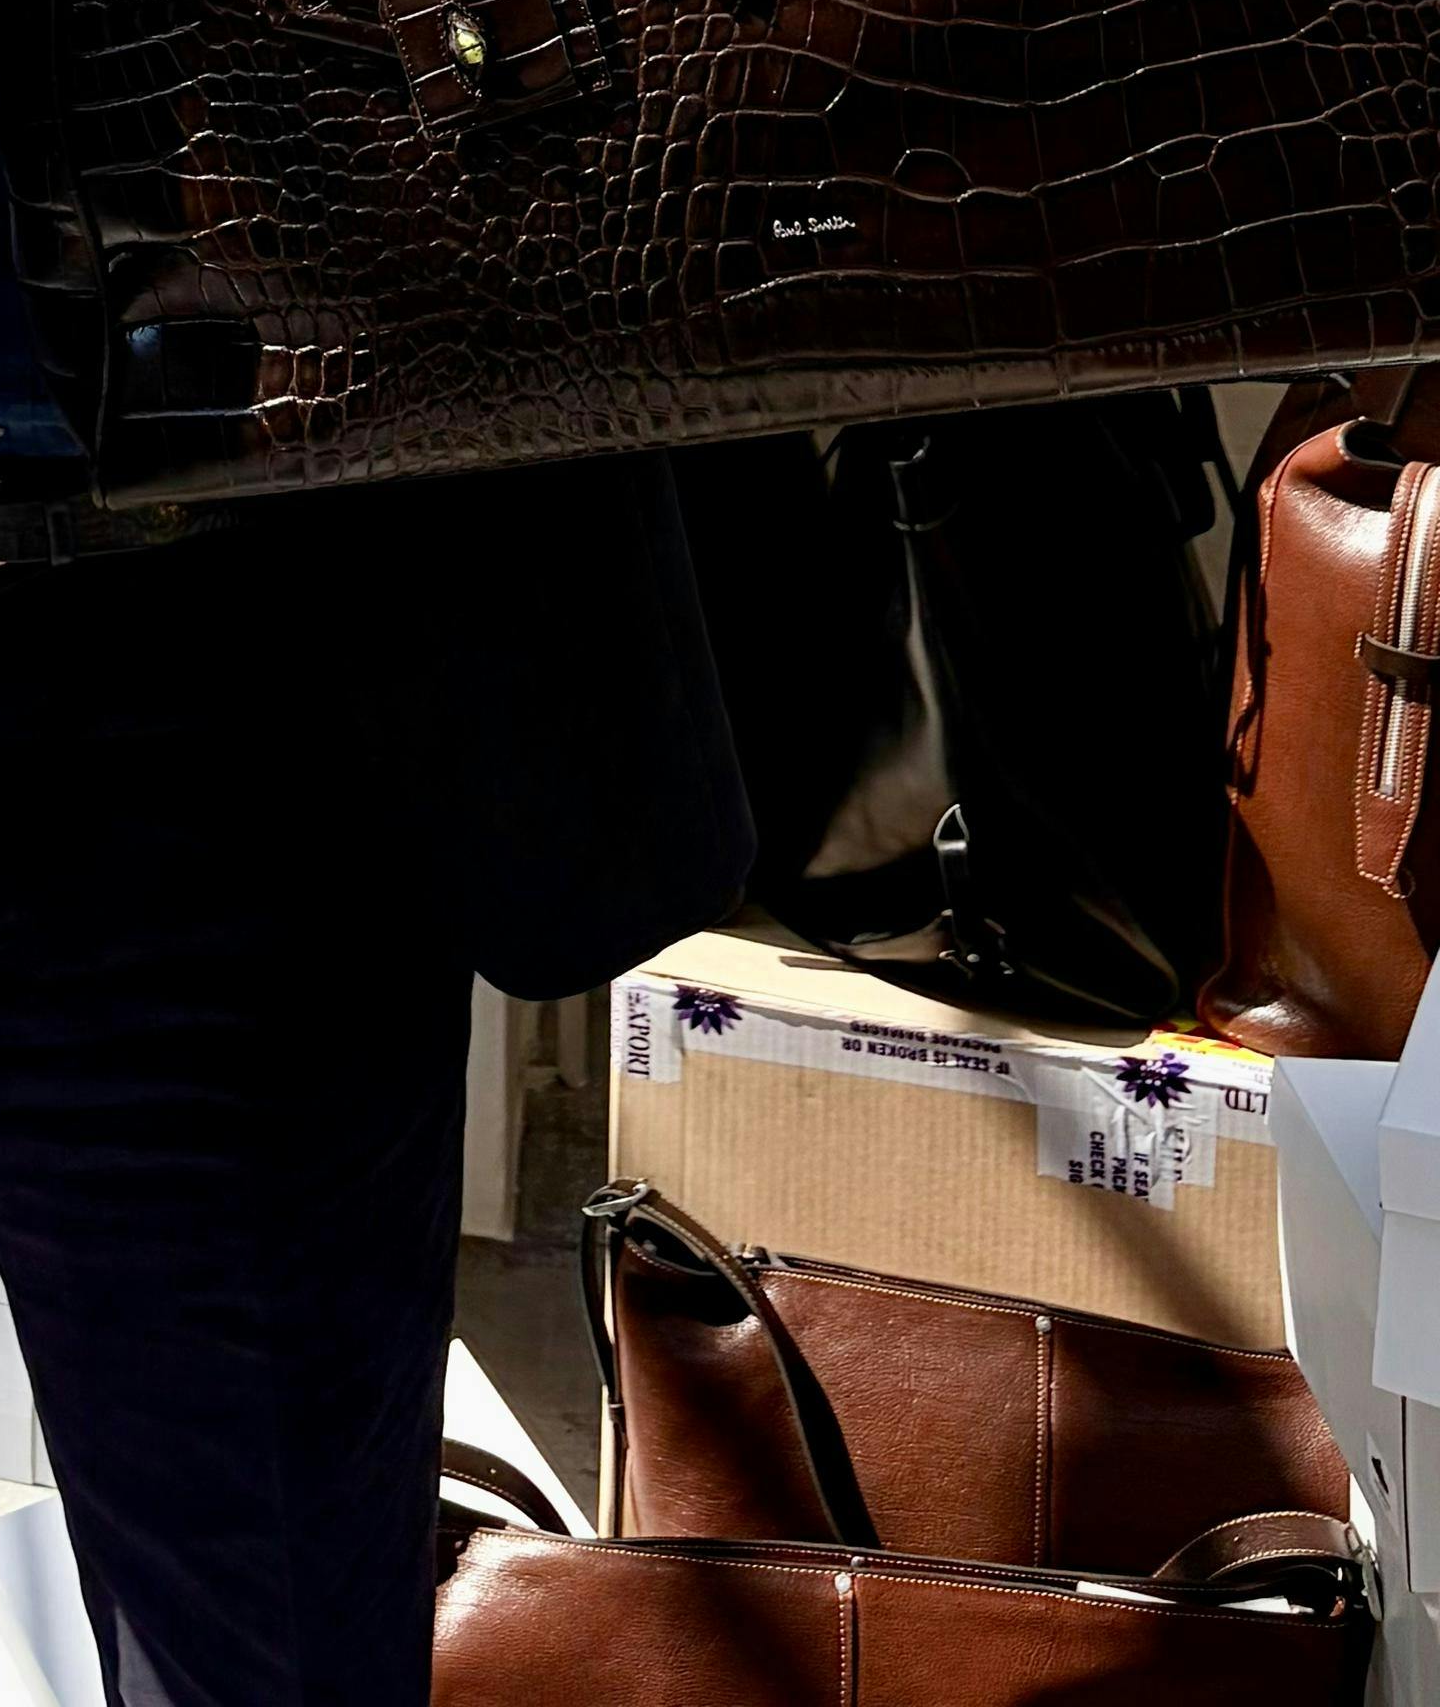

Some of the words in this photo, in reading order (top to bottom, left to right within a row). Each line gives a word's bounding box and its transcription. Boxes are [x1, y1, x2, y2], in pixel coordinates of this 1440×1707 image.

[772, 218, 806, 238] Paul
[841, 1037, 862, 1052] OR
[867, 1040, 928, 1062] BROKEN
[933, 1050, 948, 1064] IS
[954, 1052, 991, 1073] SEAL
[995, 1060, 1011, 1075] IF
[1089, 1131, 1106, 1179] CHECK
[1133, 1152, 1150, 1167] IF
[1133, 1170, 1150, 1202] SEA
